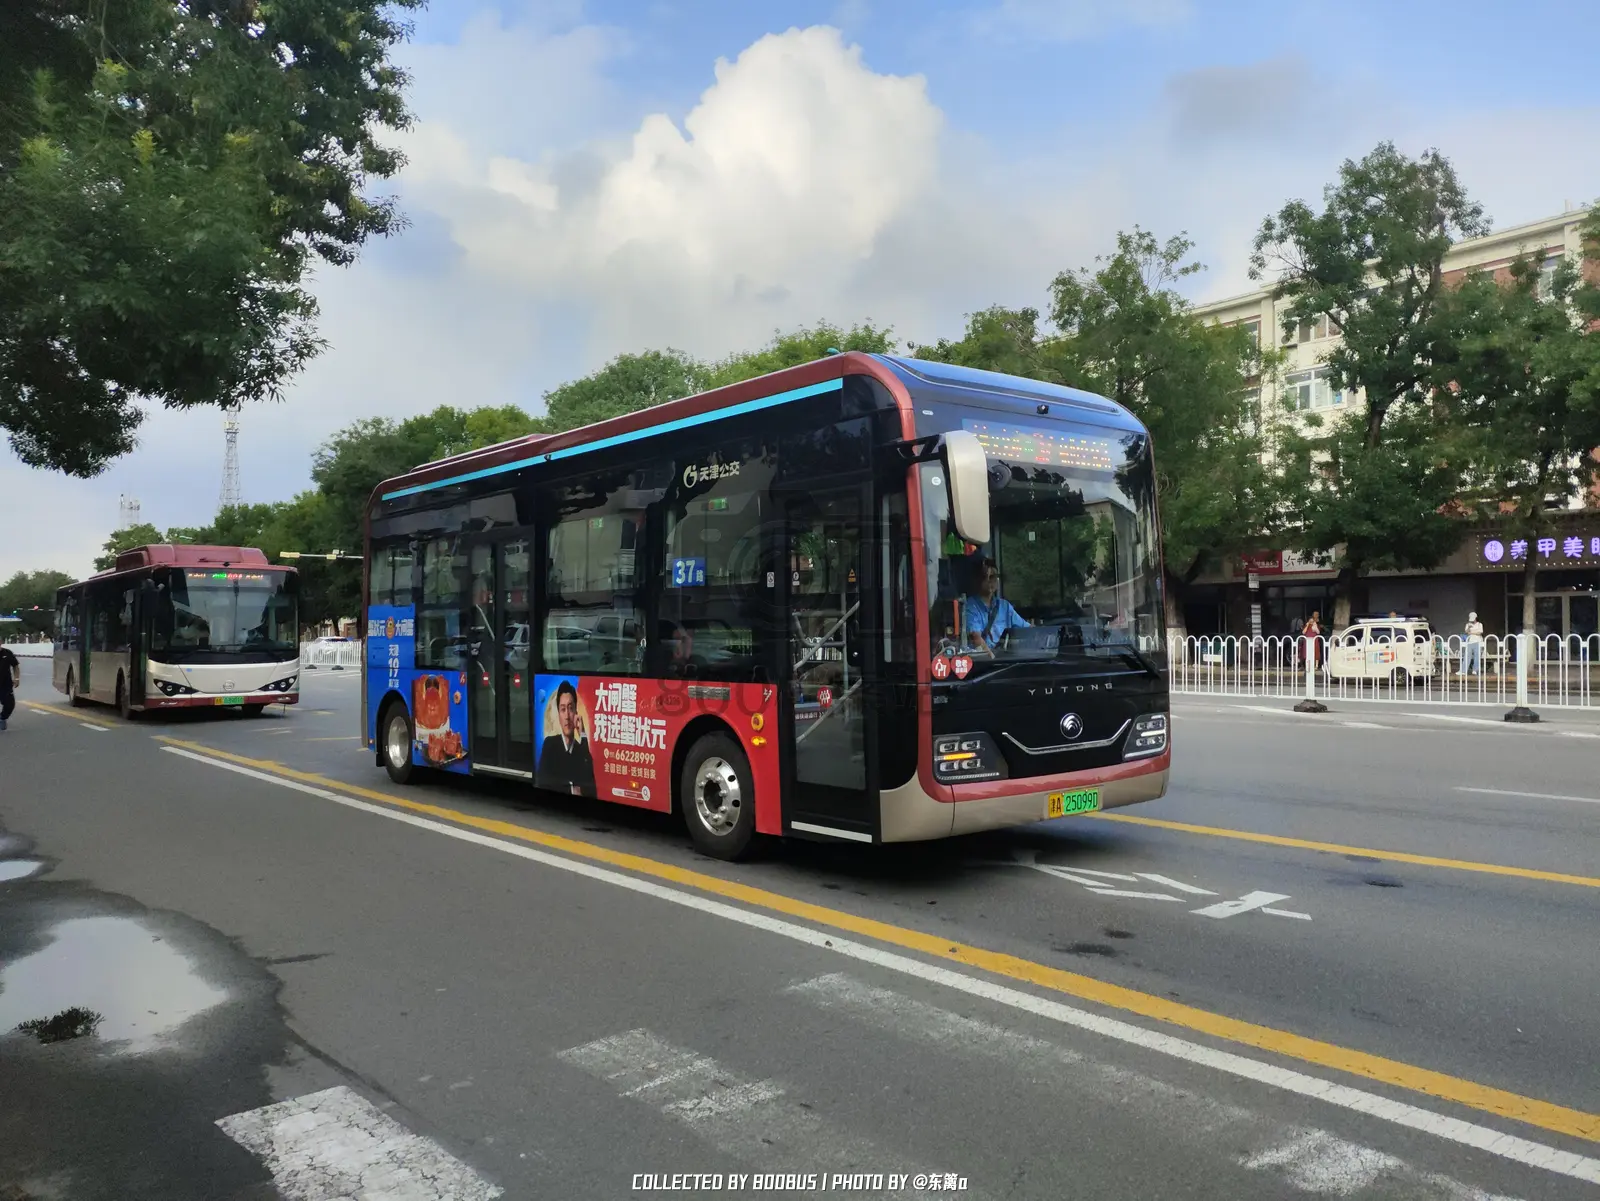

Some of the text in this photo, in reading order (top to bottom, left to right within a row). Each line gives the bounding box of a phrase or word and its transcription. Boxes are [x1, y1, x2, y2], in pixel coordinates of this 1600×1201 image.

[699, 461, 740, 482] 天津公交
[594, 682, 638, 714] 大闸蟹
[1028, 682, 1113, 696] YUTONG
[593, 713, 667, 750] 我选蟹状元
[615, 749, 656, 765] 66228999
